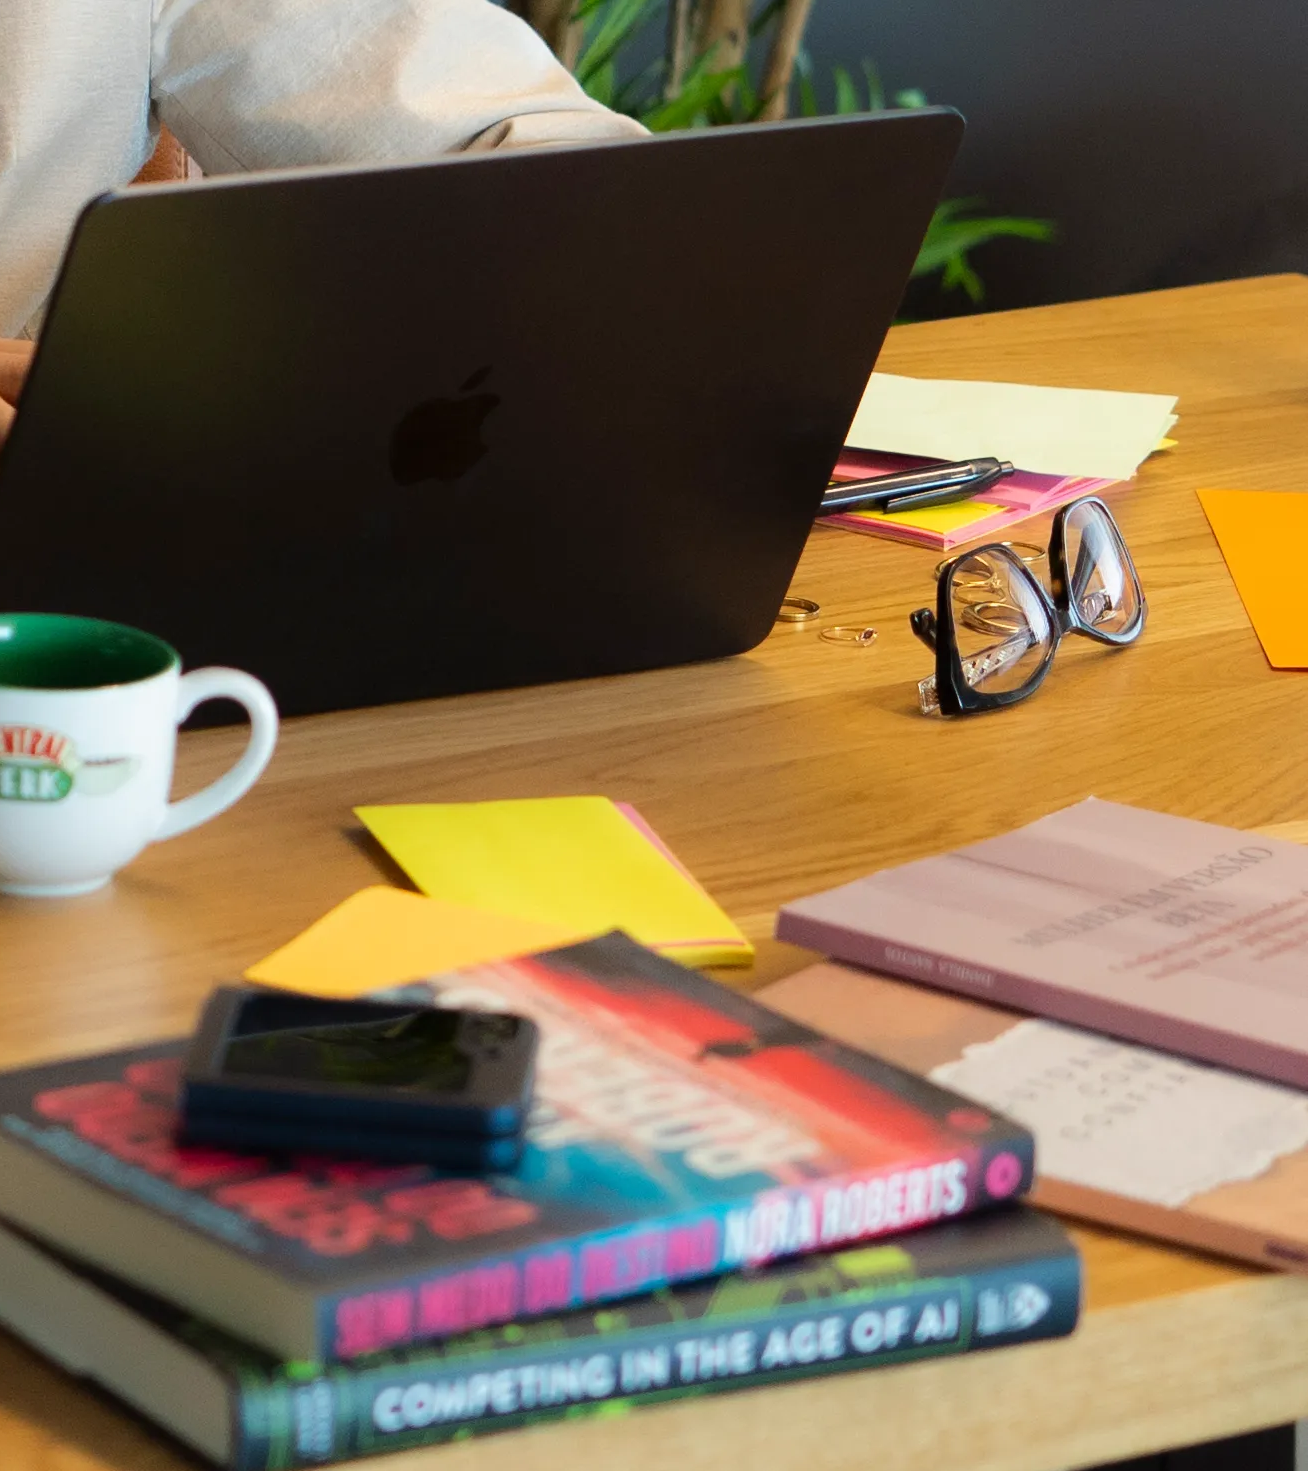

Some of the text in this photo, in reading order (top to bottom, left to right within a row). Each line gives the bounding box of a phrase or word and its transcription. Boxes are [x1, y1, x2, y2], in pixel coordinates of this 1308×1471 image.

[721, 1187, 817, 1268] NORA
[820, 1157, 970, 1240] ROBERTS
[372, 1351, 616, 1434] COMPETING
[619, 1343, 670, 1390] IN
[672, 1331, 756, 1383] THE
[760, 1314, 846, 1370] AGE
[848, 1305, 911, 1352] OF
[914, 1297, 959, 1345] AI
